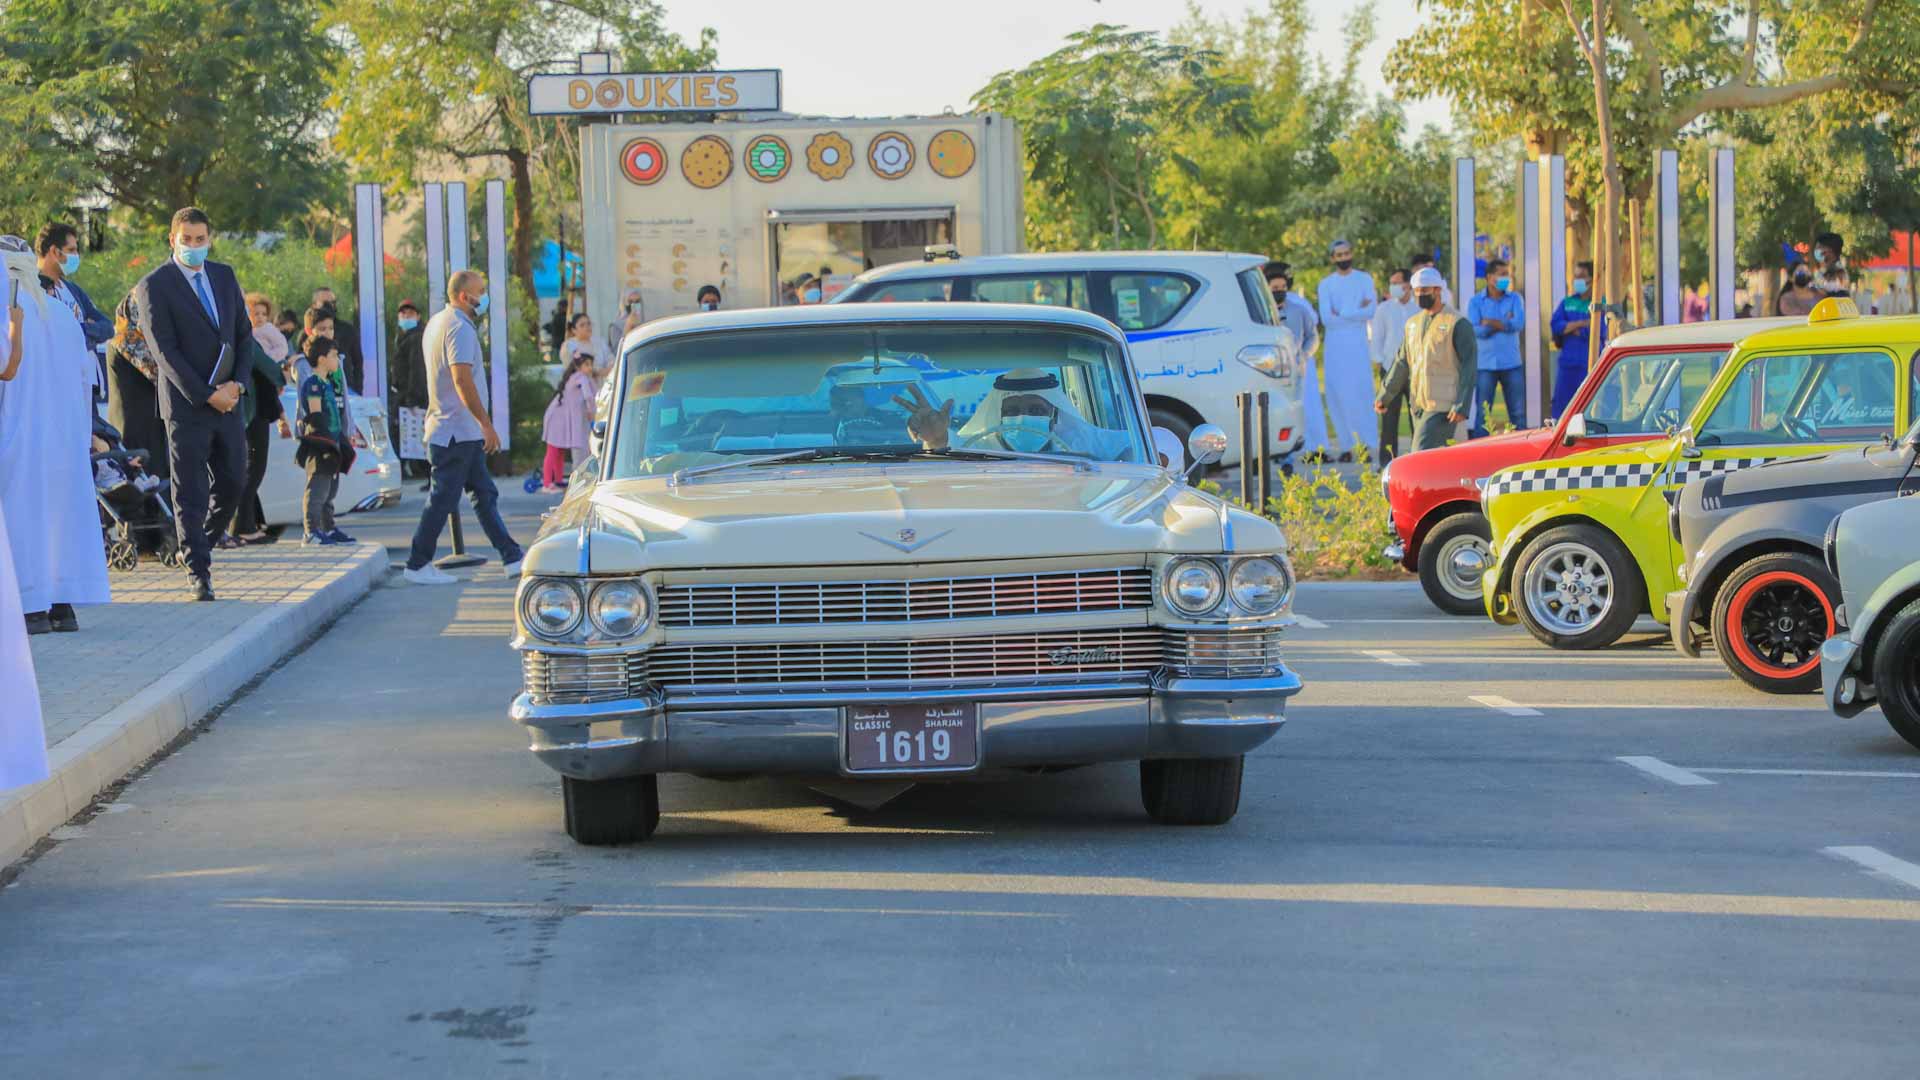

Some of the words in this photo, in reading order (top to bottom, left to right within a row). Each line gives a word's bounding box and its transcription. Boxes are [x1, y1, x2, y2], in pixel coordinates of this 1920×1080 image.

[568, 76, 739, 109] DOUKIES
[854, 720, 891, 731] CLASSIC
[925, 719, 963, 728] SHARJAH
[875, 729, 950, 763] 1619
